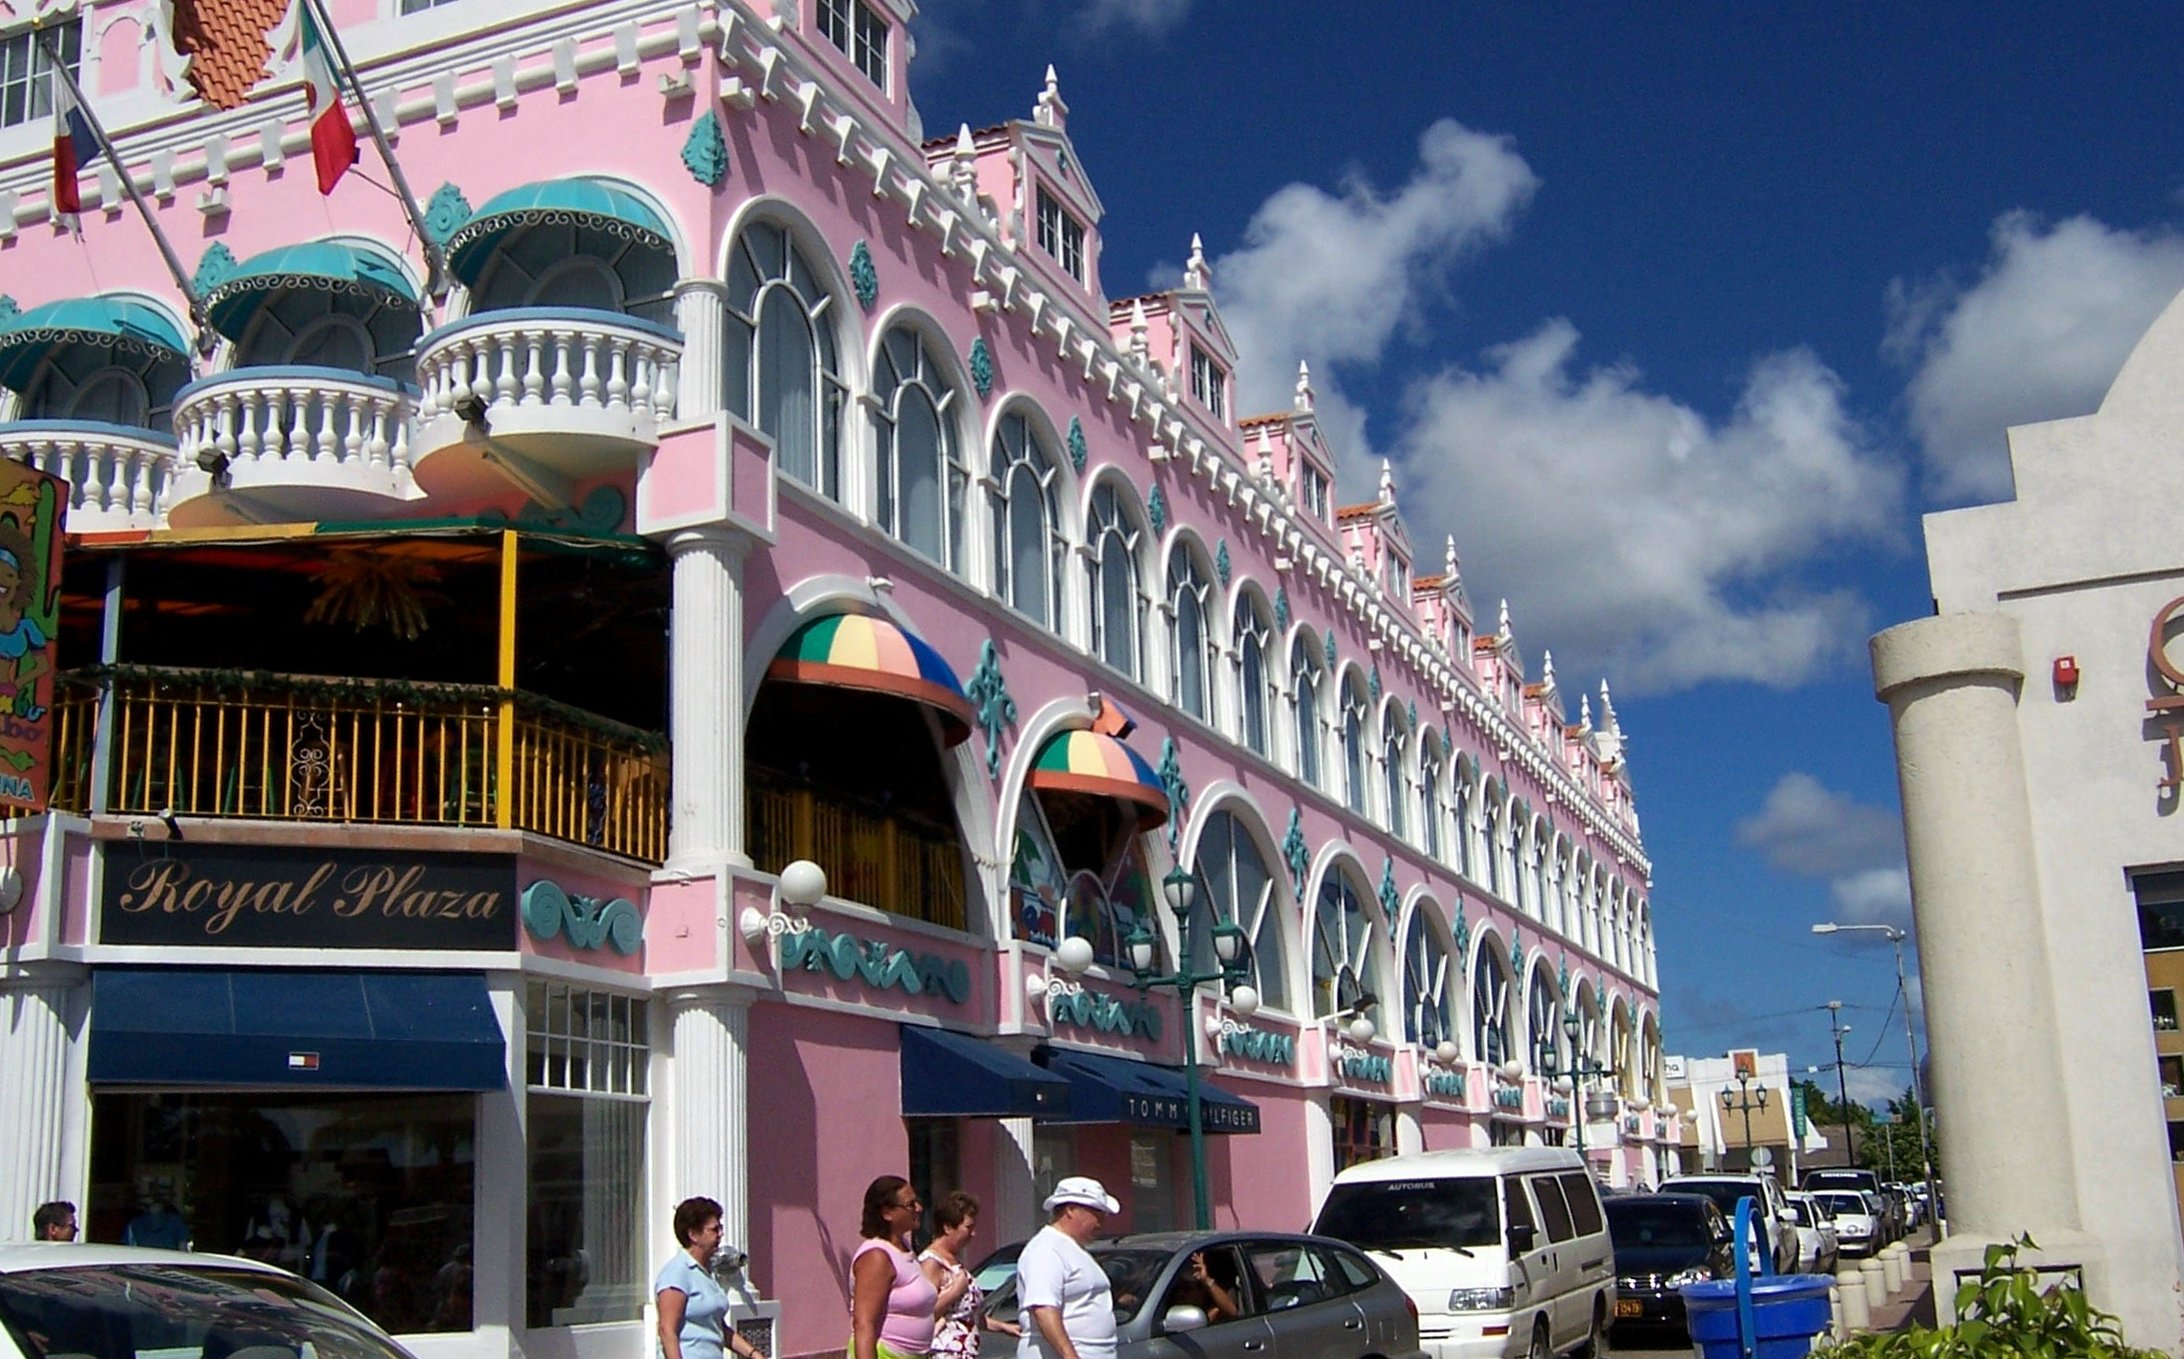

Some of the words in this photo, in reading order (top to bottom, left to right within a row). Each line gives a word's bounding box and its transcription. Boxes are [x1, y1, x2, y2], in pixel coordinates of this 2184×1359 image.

[119, 858, 338, 935] Royal
[333, 864, 502, 920] Plaza
[1129, 1098, 1188, 1119] TOMM
